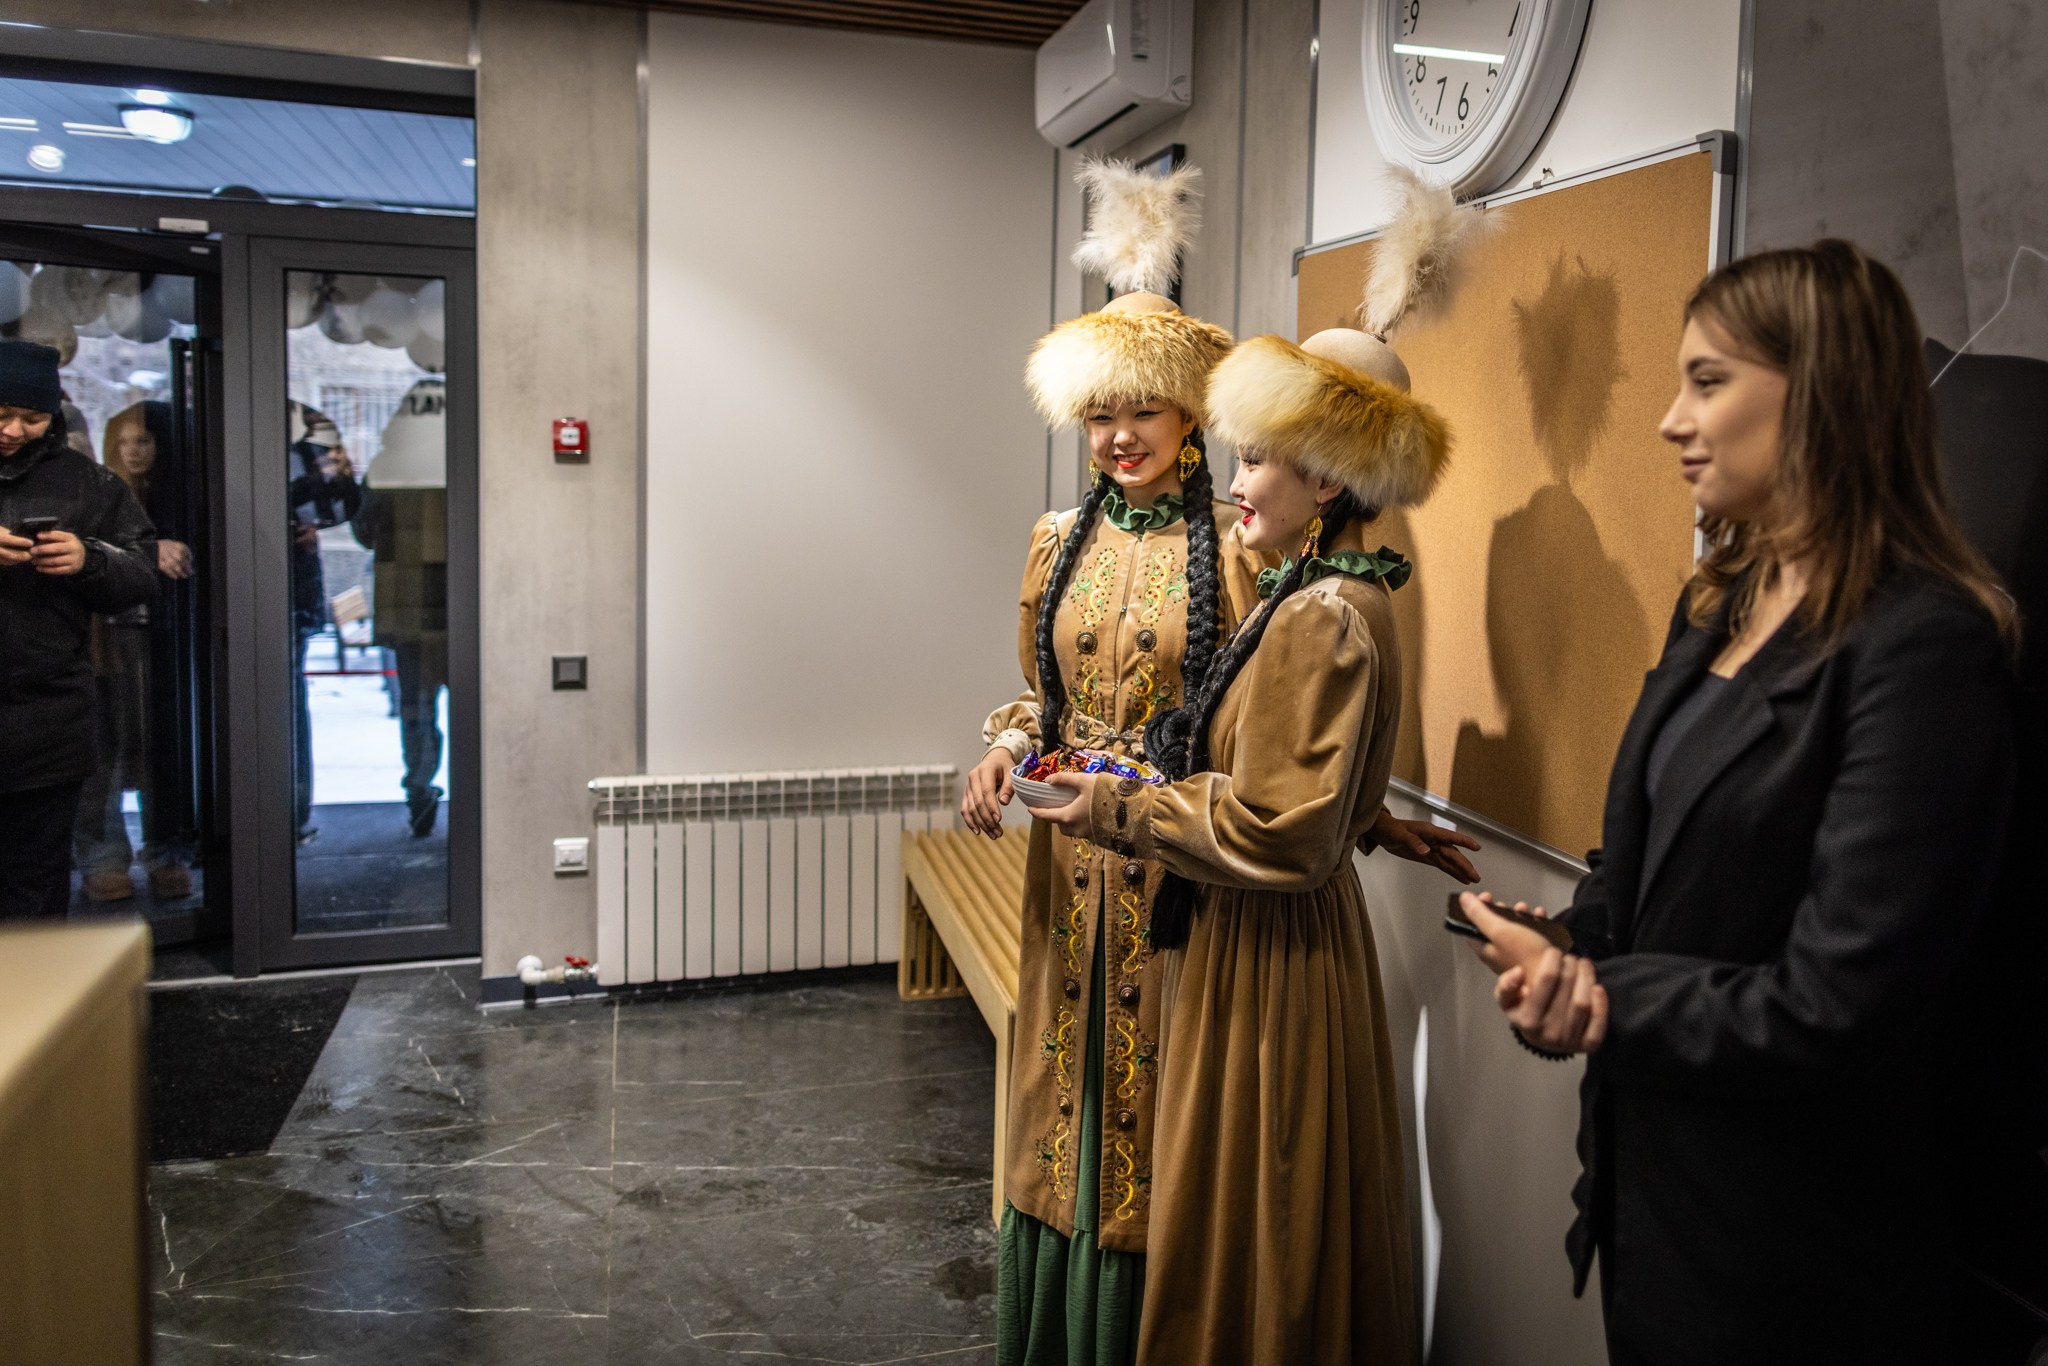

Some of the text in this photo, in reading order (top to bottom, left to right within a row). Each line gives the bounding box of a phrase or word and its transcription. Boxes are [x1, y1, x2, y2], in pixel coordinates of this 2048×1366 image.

[1410, 0, 1420, 34] 9
[1415, 54, 1427, 84] 8
[1436, 76, 1447, 115] 7
[1458, 82, 1469, 120] 6
